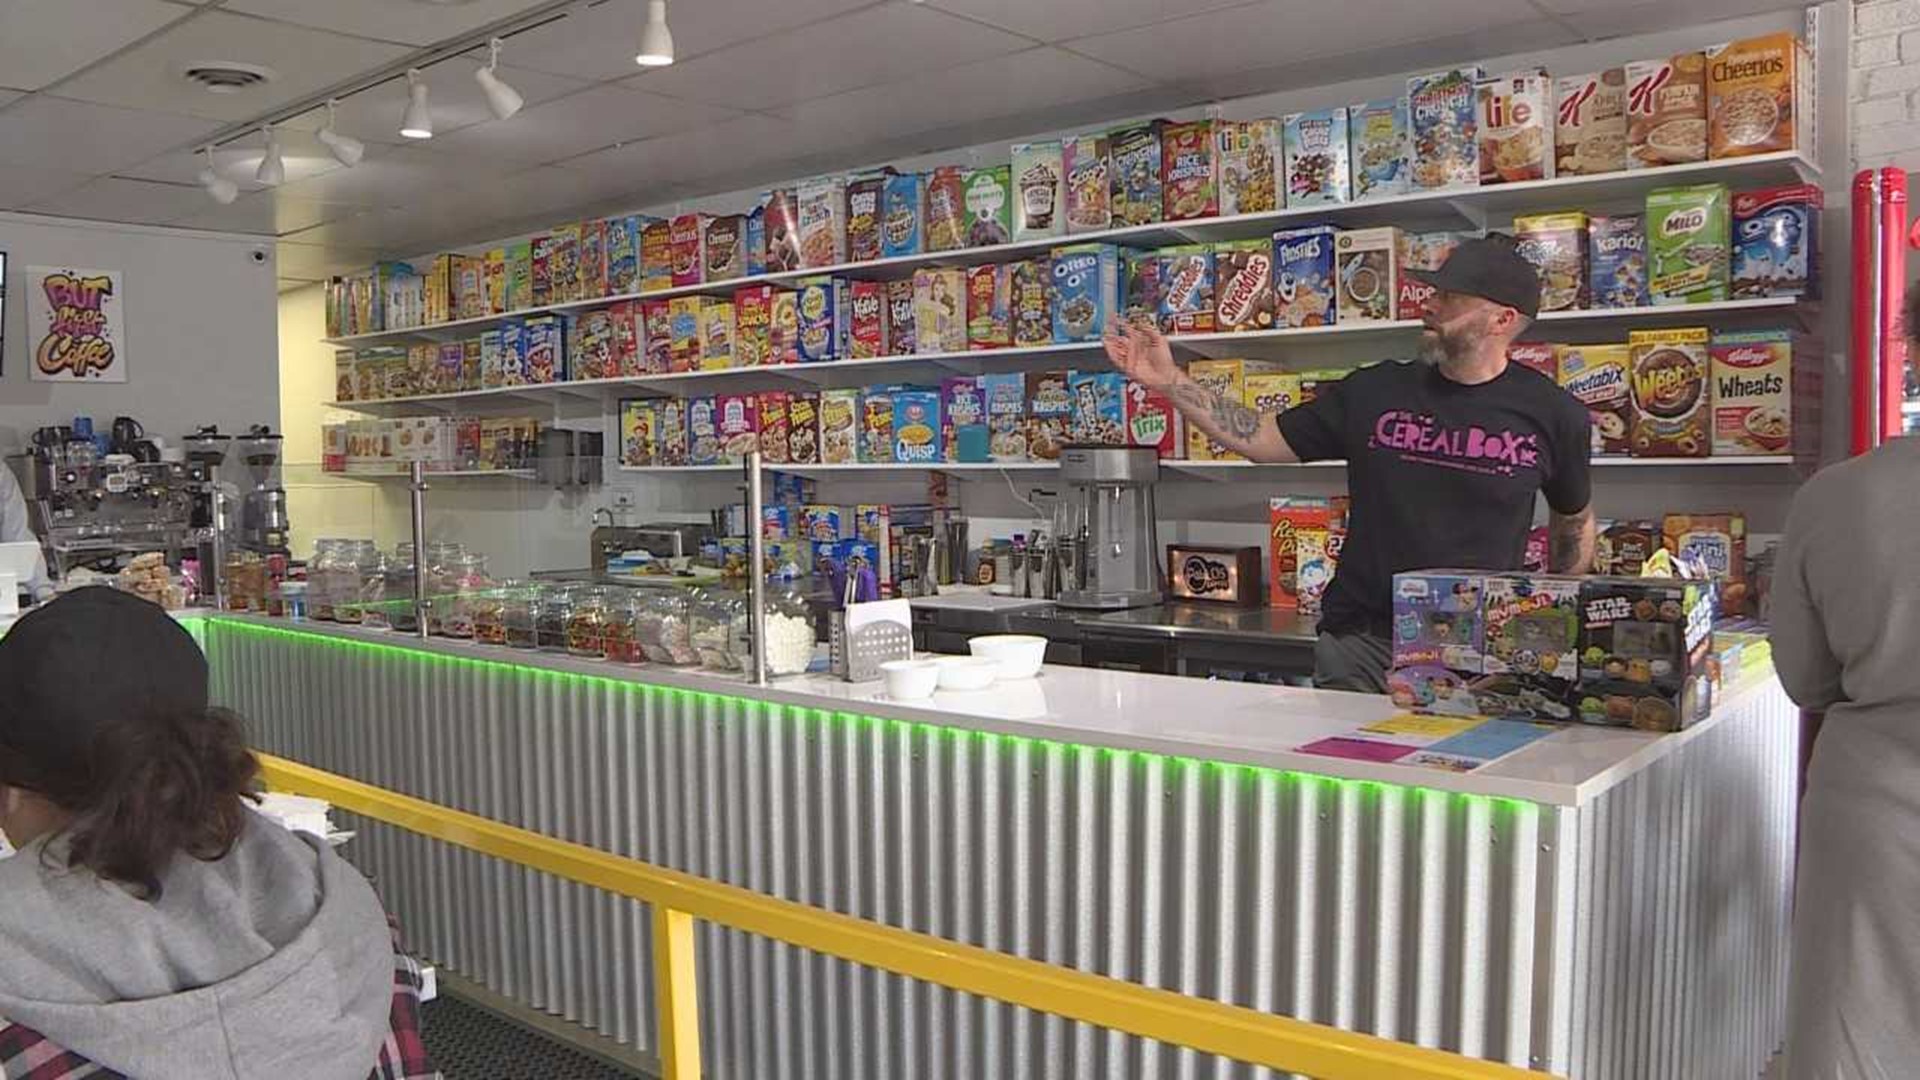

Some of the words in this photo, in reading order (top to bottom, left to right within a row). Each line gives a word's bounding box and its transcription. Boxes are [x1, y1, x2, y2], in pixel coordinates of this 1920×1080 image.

[1713, 57, 1783, 83] Cheerios
[1629, 66, 1671, 114] K
[1558, 81, 1597, 127] K
[1665, 213, 1703, 232] MILO
[43, 274, 113, 312] BUT
[1221, 258, 1267, 321] Shreddies
[1400, 285, 1437, 302] Alpe
[1718, 373, 1783, 399] Wheats
[1132, 414, 1167, 438] Trix
[1585, 597, 1632, 611] STAR
[1587, 606, 1632, 621] WARS
